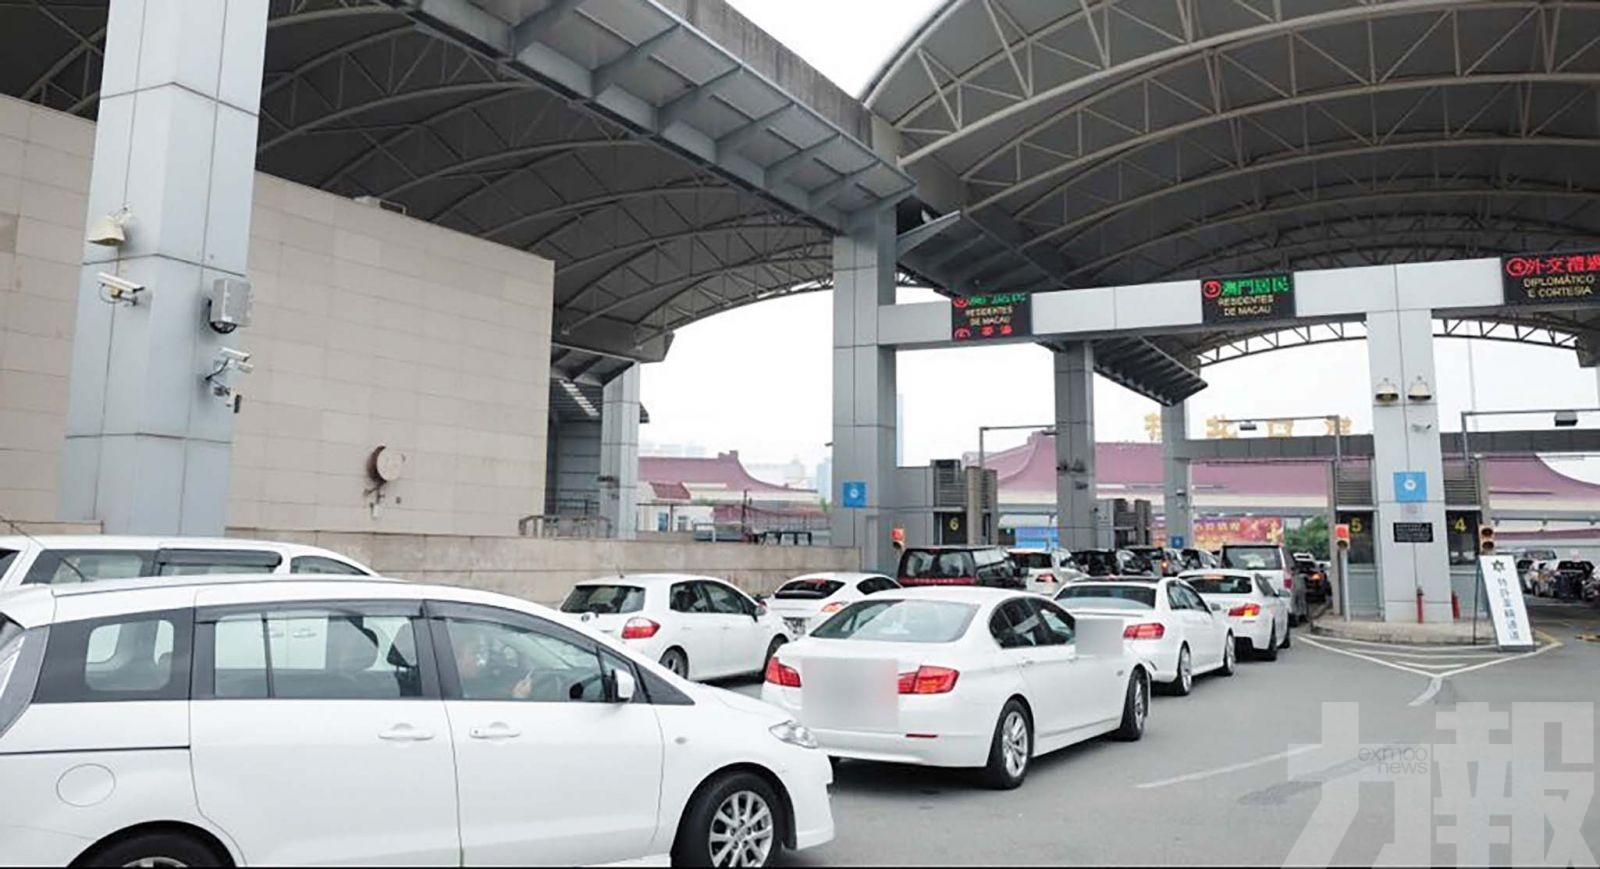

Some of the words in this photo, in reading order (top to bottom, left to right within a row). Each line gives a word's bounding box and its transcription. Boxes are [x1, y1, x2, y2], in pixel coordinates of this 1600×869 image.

[1538, 286, 1593, 297] CORTESIA
[1218, 294, 1274, 306] RESIDENTES
[1224, 308, 1236, 316] DE
[1238, 305, 1271, 315] MACAU
[949, 516, 960, 531] 6
[1352, 518, 1361, 532] 5
[1455, 518, 1466, 532] 4
